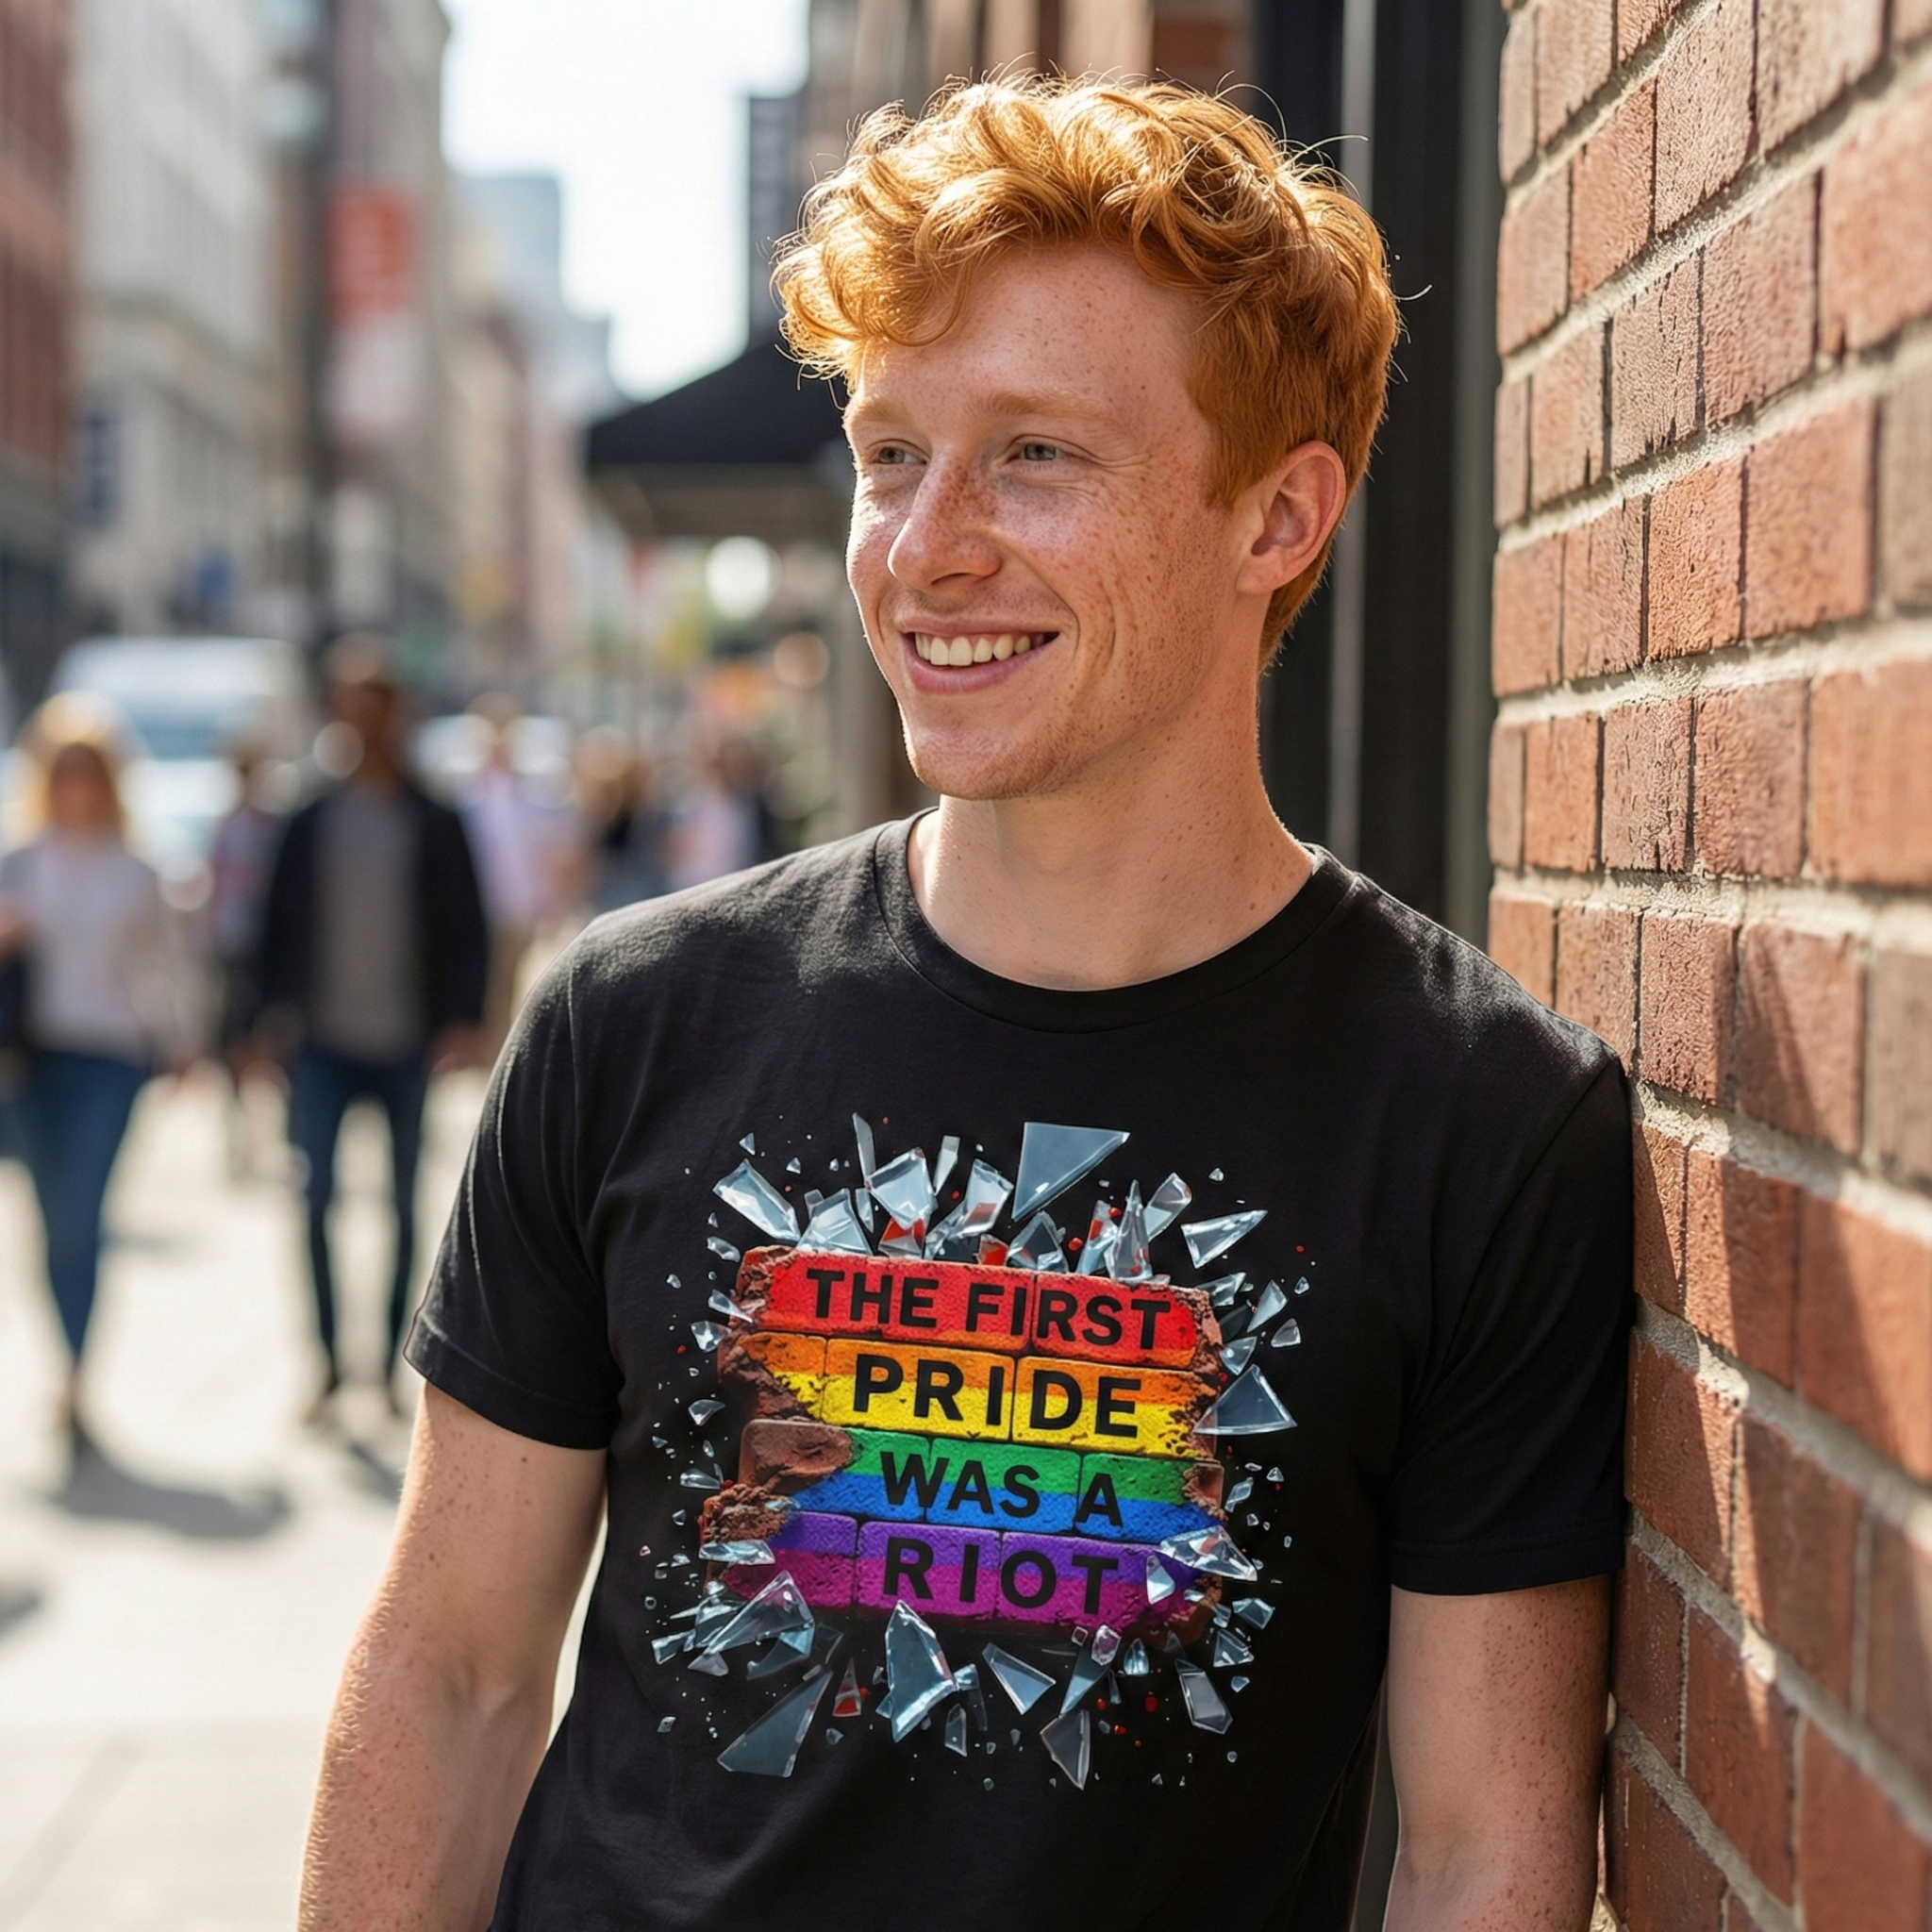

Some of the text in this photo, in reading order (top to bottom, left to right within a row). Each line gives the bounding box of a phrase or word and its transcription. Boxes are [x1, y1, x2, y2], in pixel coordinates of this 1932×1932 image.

[806, 1268, 1171, 1350] THE FIRST
[853, 1353, 1141, 1439] PRIDE
[880, 1451, 1124, 1528] WAS A
[882, 1536, 1119, 1615] RIOT
